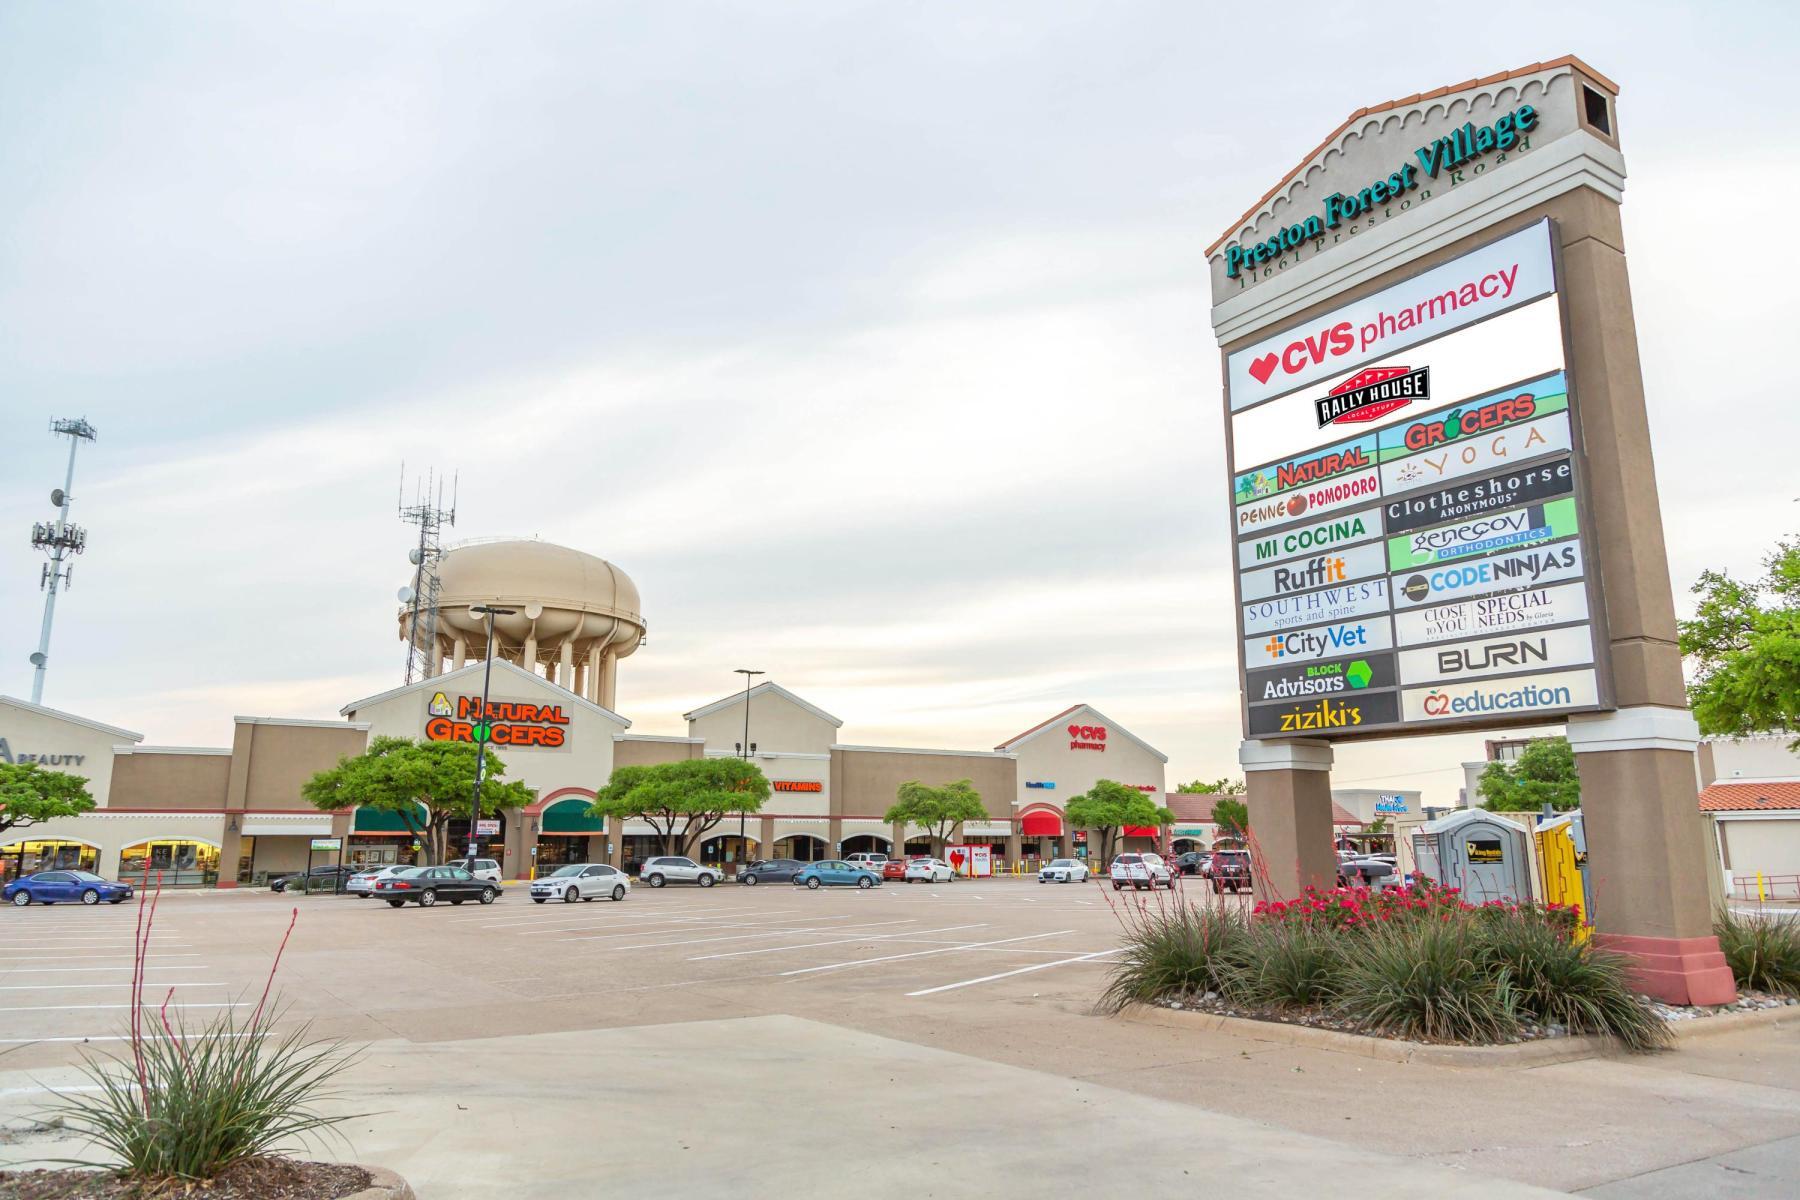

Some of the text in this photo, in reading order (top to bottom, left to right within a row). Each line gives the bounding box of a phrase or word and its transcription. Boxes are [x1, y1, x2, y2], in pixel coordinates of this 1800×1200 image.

[1226, 104, 1540, 279] Preston Forest Village
[1239, 135, 1532, 289] 11661 Preston Road
[1282, 264, 1519, 375] CVS pharmacy
[1321, 374, 1423, 421] RALLY HOUSE
[1347, 410, 1369, 419] LOCAL
[1423, 426, 1547, 475] YOGA
[1277, 446, 1370, 490] NATURAL
[1240, 476, 1377, 527] PENNE POMODORO
[1388, 464, 1570, 519] Clotheshorse
[1440, 494, 1513, 518] ANONYMOUS
[1256, 517, 1366, 560] MI COCINA
[1440, 528, 1547, 558] ORTHODONTICS
[1274, 556, 1347, 593] Ruffit
[1430, 547, 1576, 592] CODE NINJAS
[1249, 580, 1386, 621] SOUTHWEST
[1424, 604, 1467, 622] CLOSE
[1477, 590, 1553, 616] SPECIAL
[1274, 605, 1356, 628] sports and spine
[1436, 617, 1467, 633] YOU
[1478, 610, 1525, 629] NEEDS
[1285, 625, 1367, 658] CityVet
[1437, 638, 1548, 674] BURN
[1307, 663, 1343, 677] BLOCK
[1263, 676, 1345, 699] Advisors
[1451, 685, 1571, 713] education
[1070, 740, 1106, 752] pharmacy
[1080, 725, 1107, 741] CVS
[773, 780, 823, 793] VITAMINS
